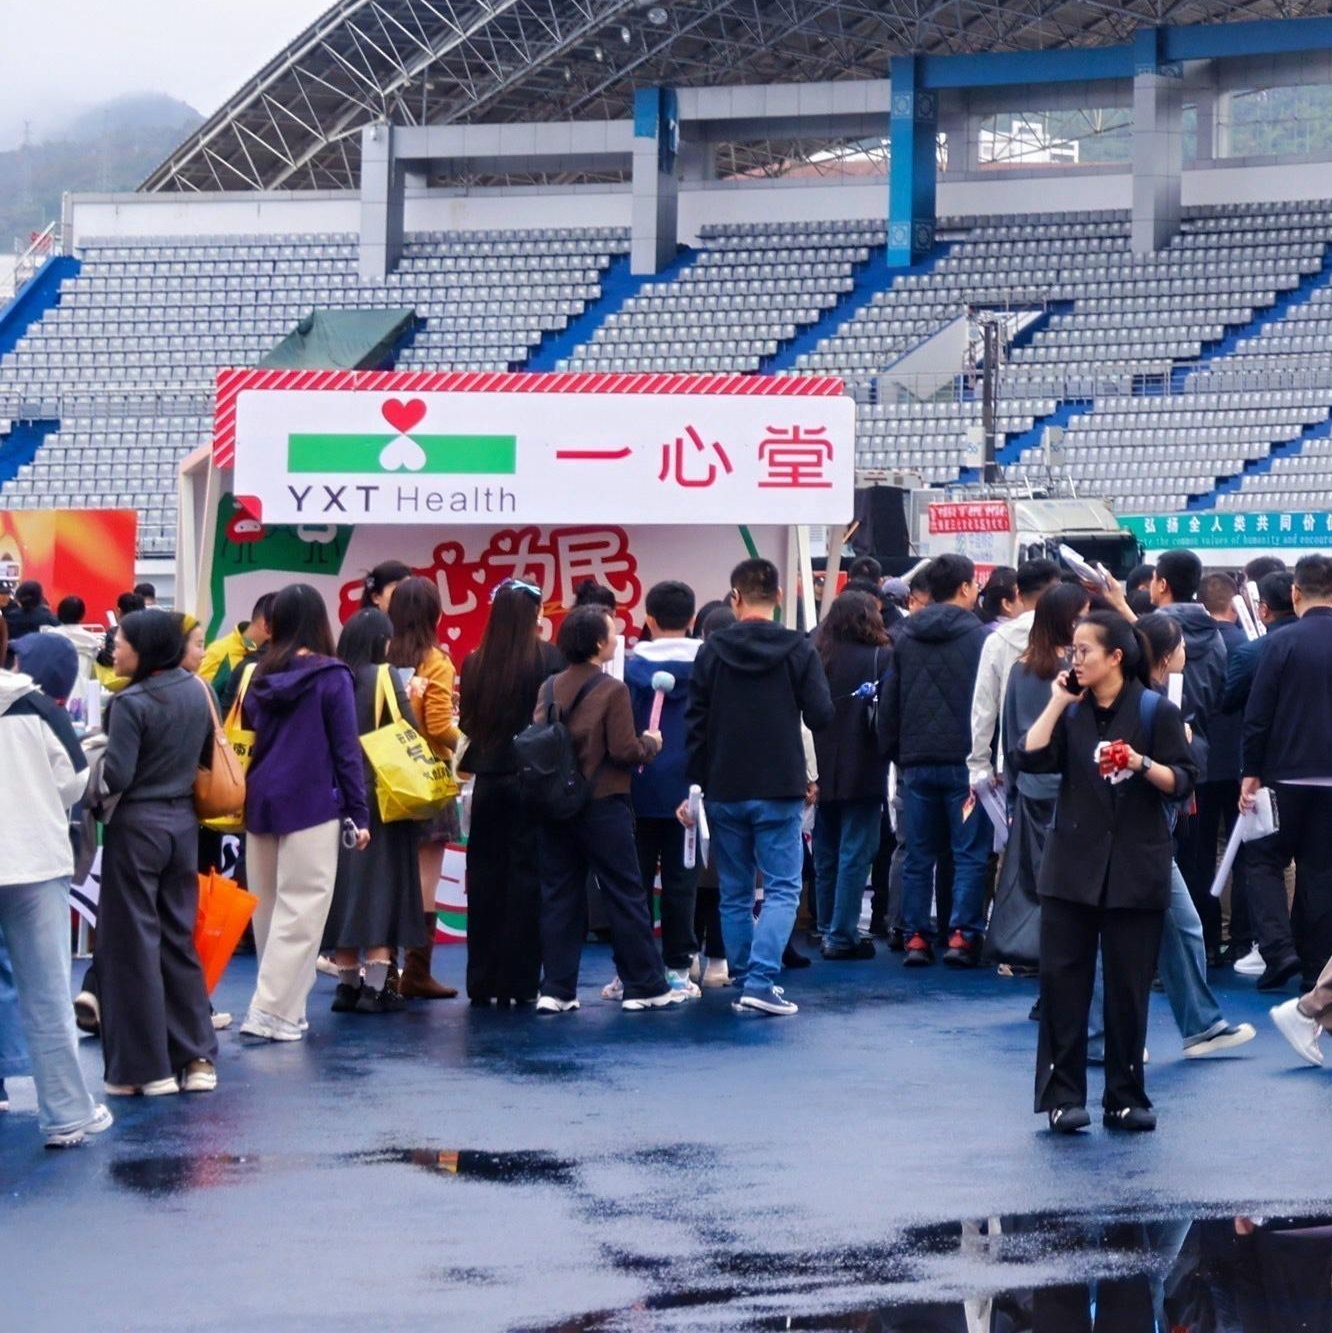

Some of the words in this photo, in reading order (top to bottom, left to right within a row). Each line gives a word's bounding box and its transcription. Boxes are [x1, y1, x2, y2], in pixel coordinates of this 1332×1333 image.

[555, 424, 834, 489] 一心堂
[287, 486, 379, 512] YXT
[397, 487, 517, 512] Health
